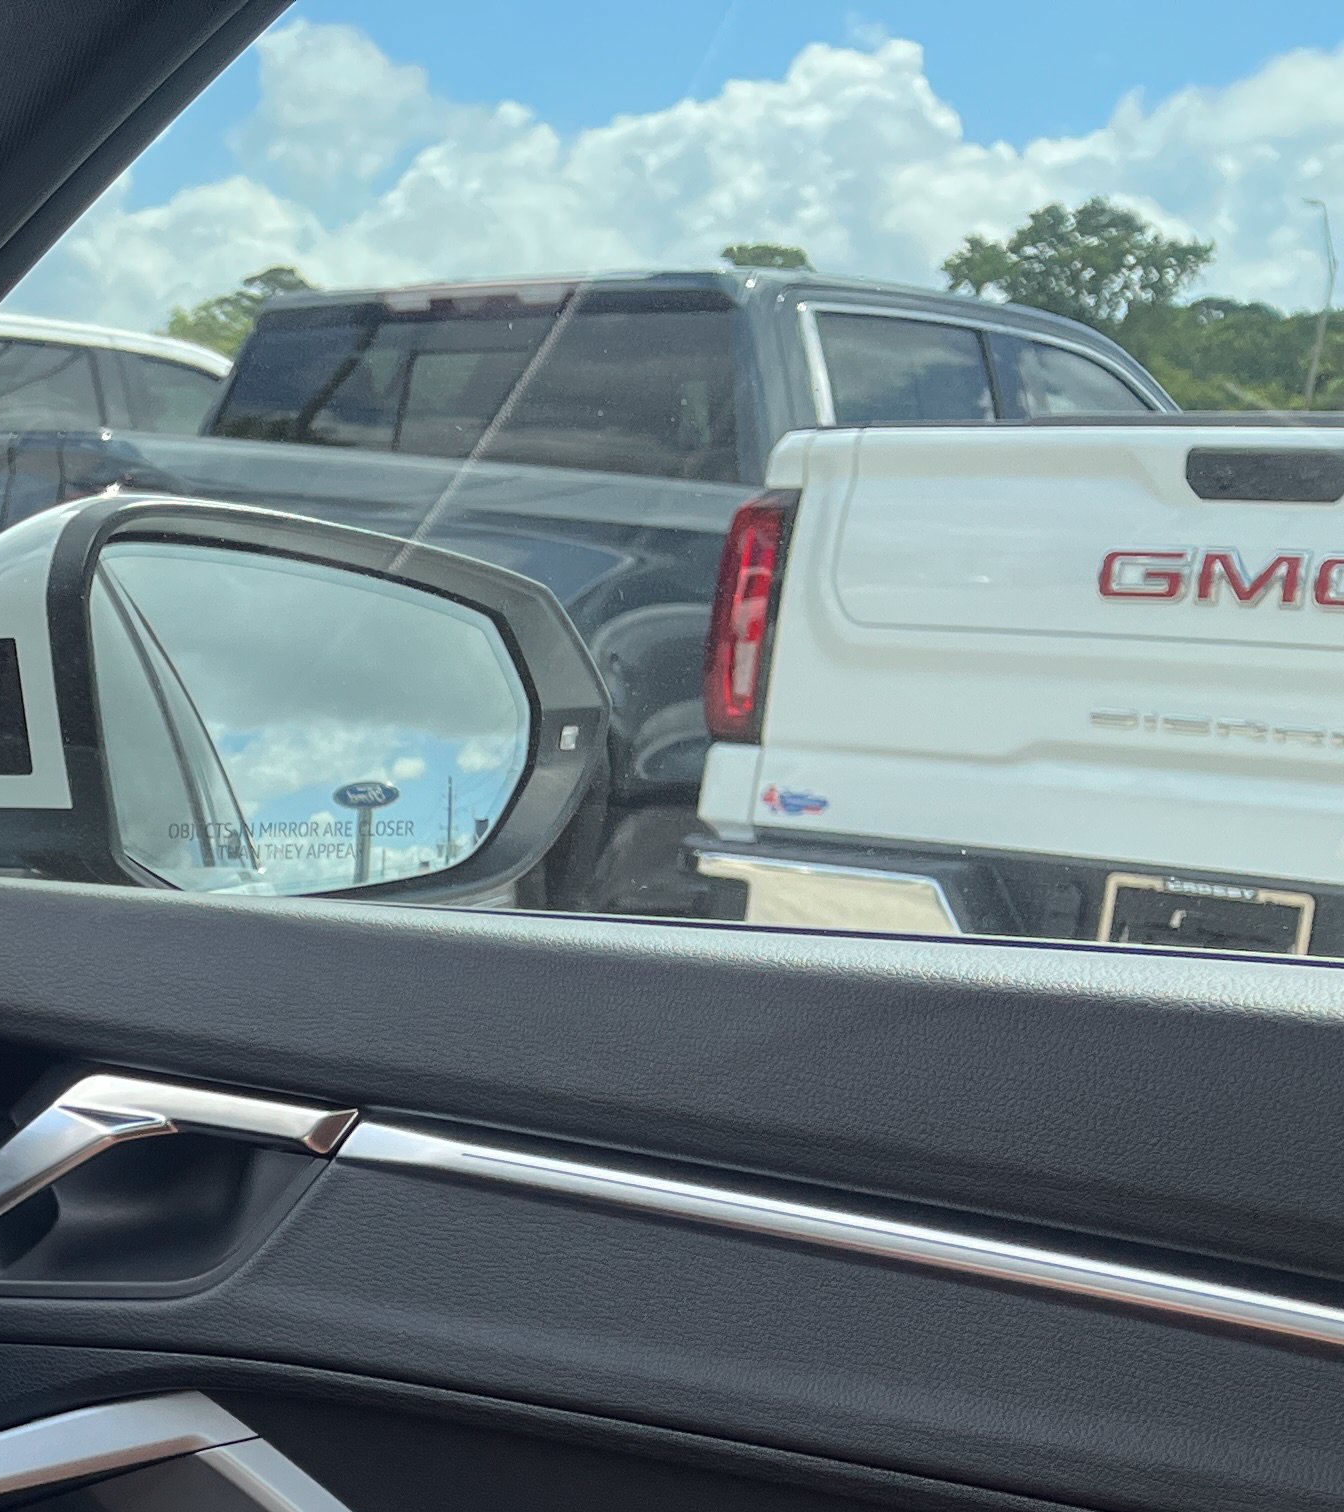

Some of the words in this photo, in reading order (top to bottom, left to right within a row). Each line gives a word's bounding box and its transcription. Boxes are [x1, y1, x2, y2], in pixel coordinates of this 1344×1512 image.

[1090, 706, 1344, 748] SIERR
[259, 821, 319, 838] MIRROR
[322, 820, 353, 837] ARE
[359, 820, 415, 837] CLOSER
[264, 843, 304, 860] THEY
